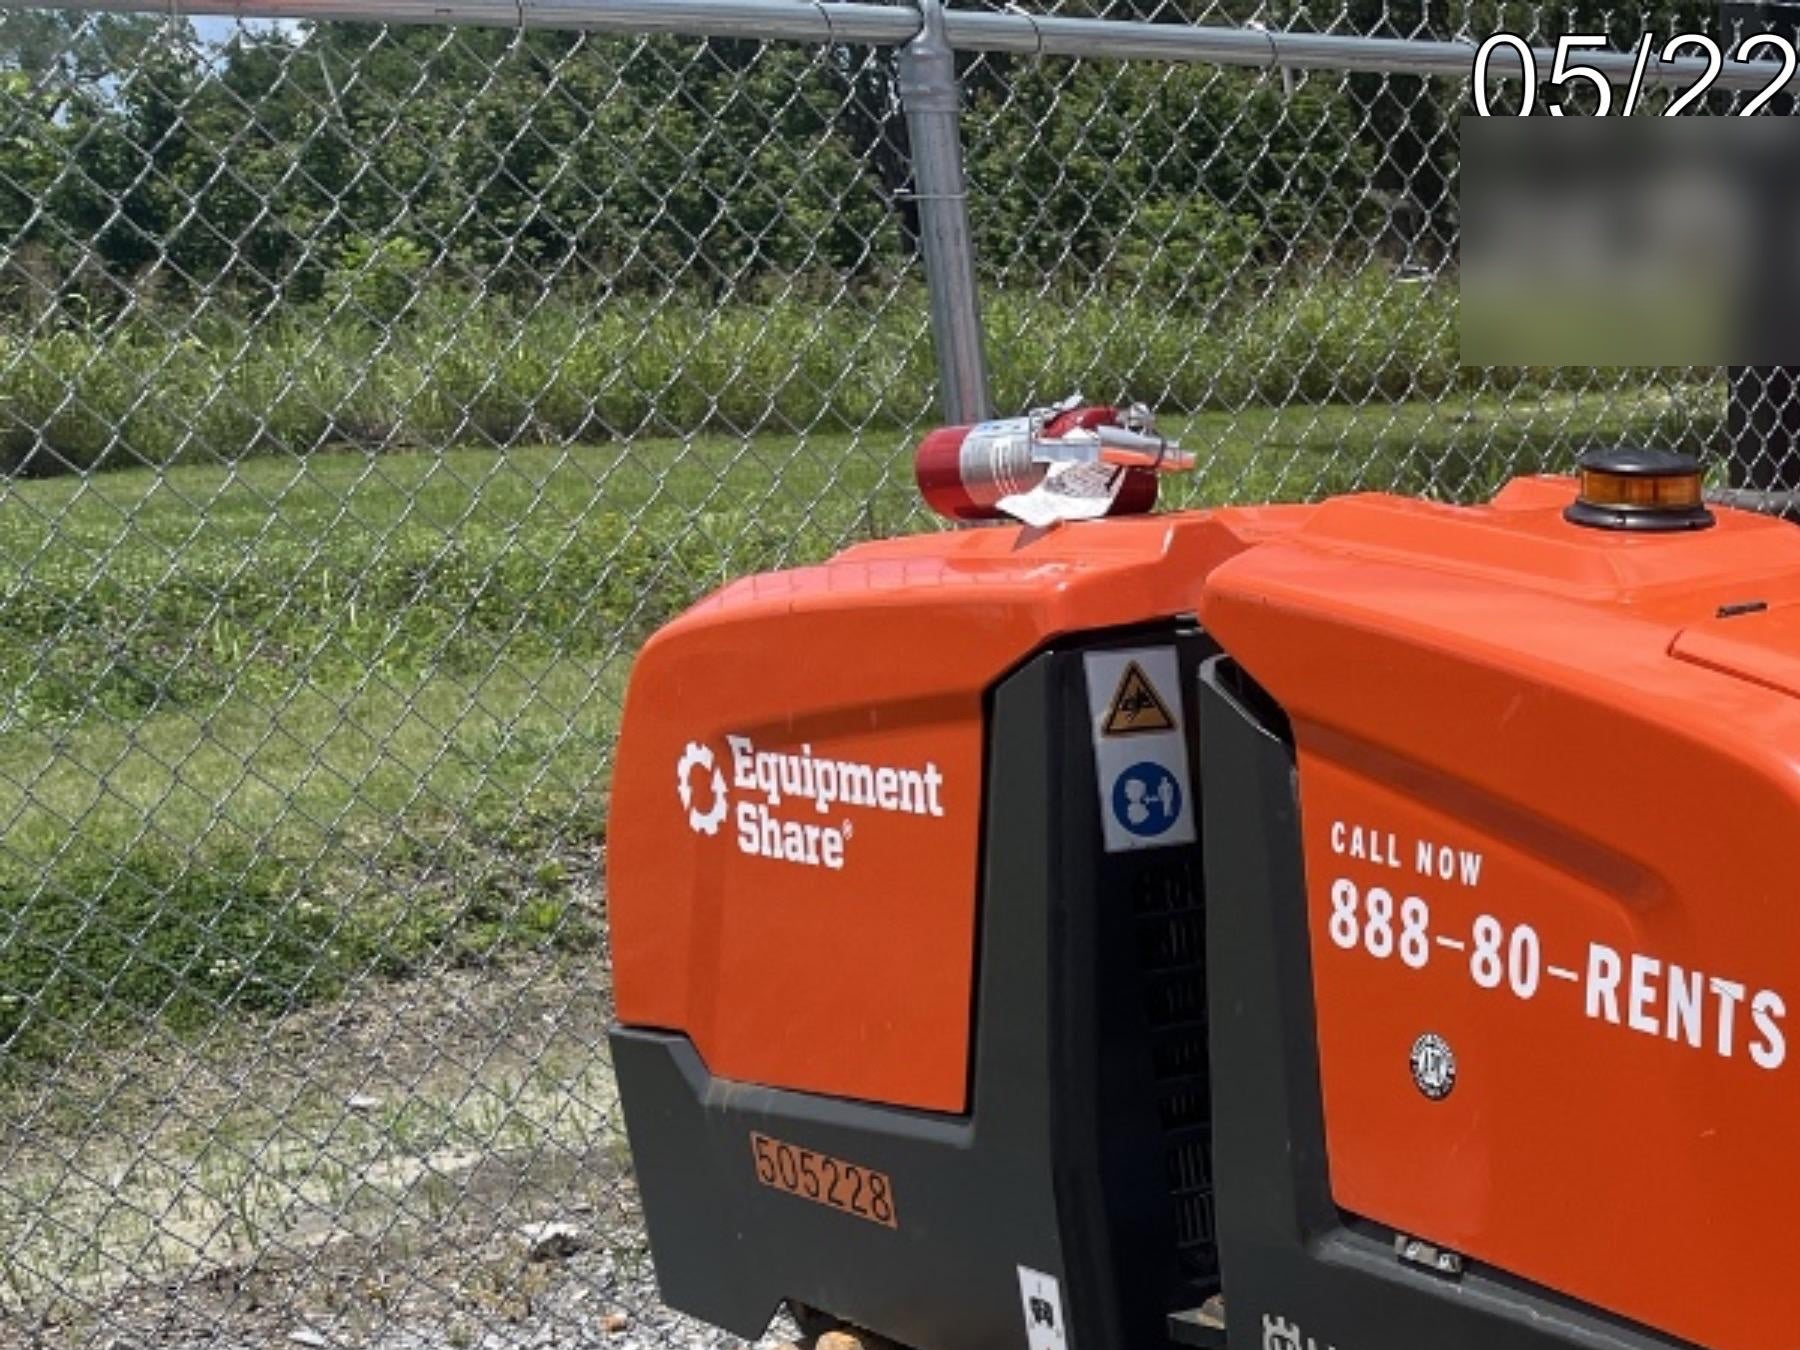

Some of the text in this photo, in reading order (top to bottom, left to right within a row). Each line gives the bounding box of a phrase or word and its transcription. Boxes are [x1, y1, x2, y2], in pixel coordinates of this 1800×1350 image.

[726, 734, 945, 817] Equipment
[1330, 820, 1483, 887] CALL NOW
[1328, 878, 1788, 1070] 888-80-RENTS
[755, 1137, 893, 1222] 505228
